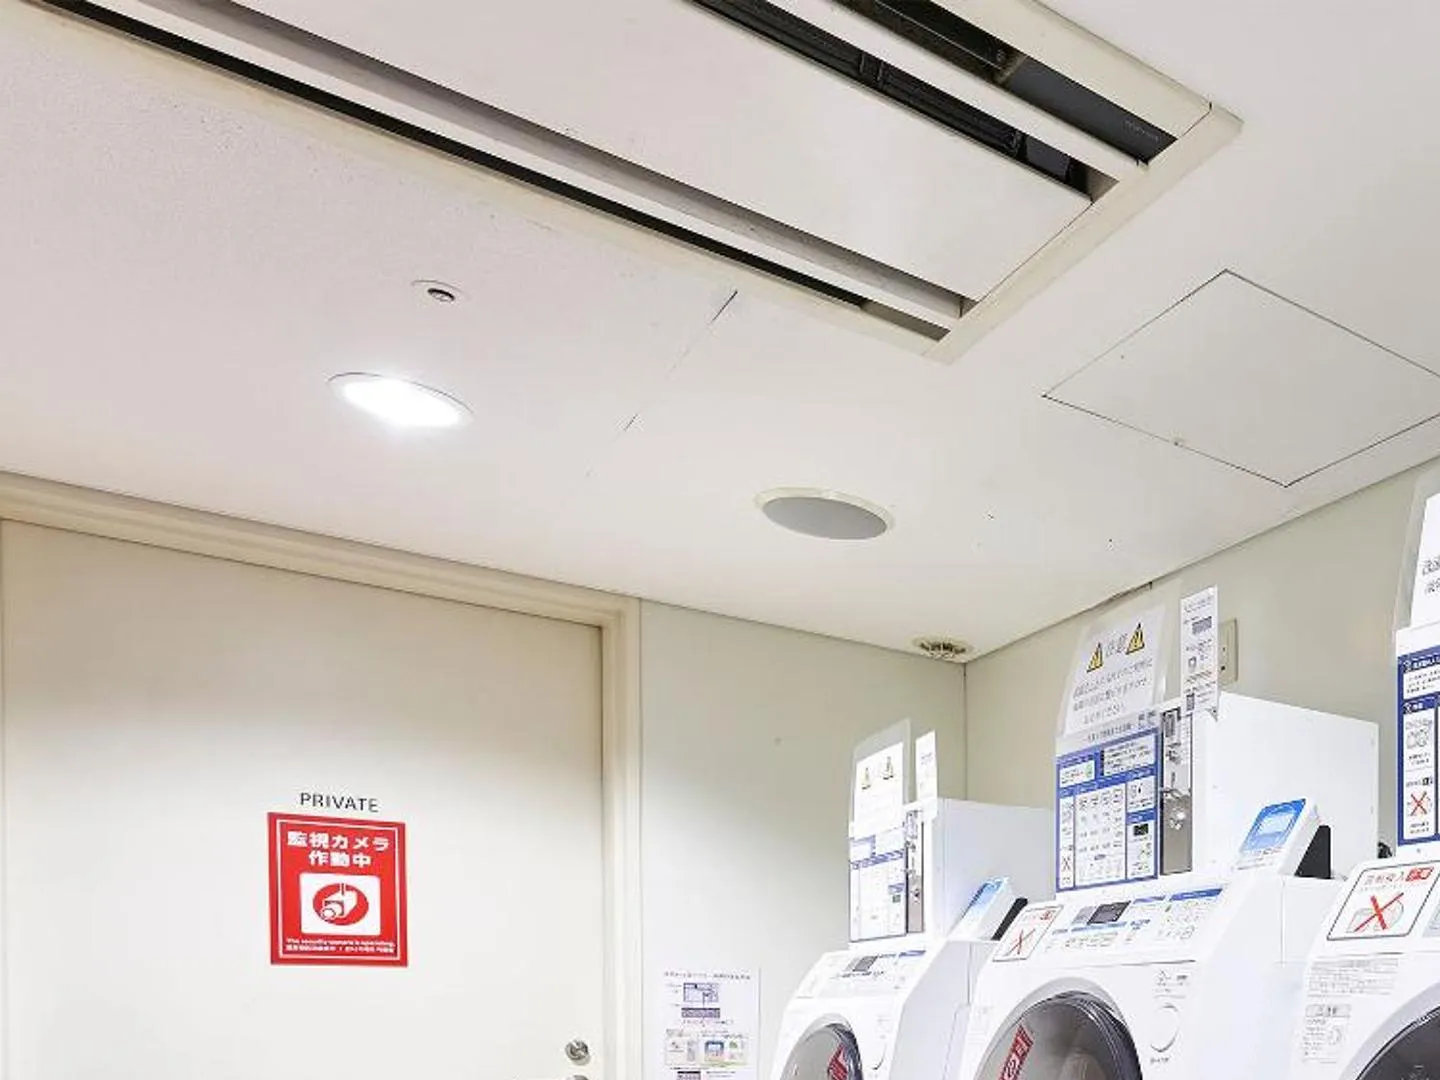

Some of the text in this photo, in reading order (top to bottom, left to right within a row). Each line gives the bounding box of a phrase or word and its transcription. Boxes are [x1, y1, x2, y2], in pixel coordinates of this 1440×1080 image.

[299, 792, 379, 812] PRIVATE
[287, 831, 390, 851] 監視カメラ
[308, 851, 372, 868] 作動中
